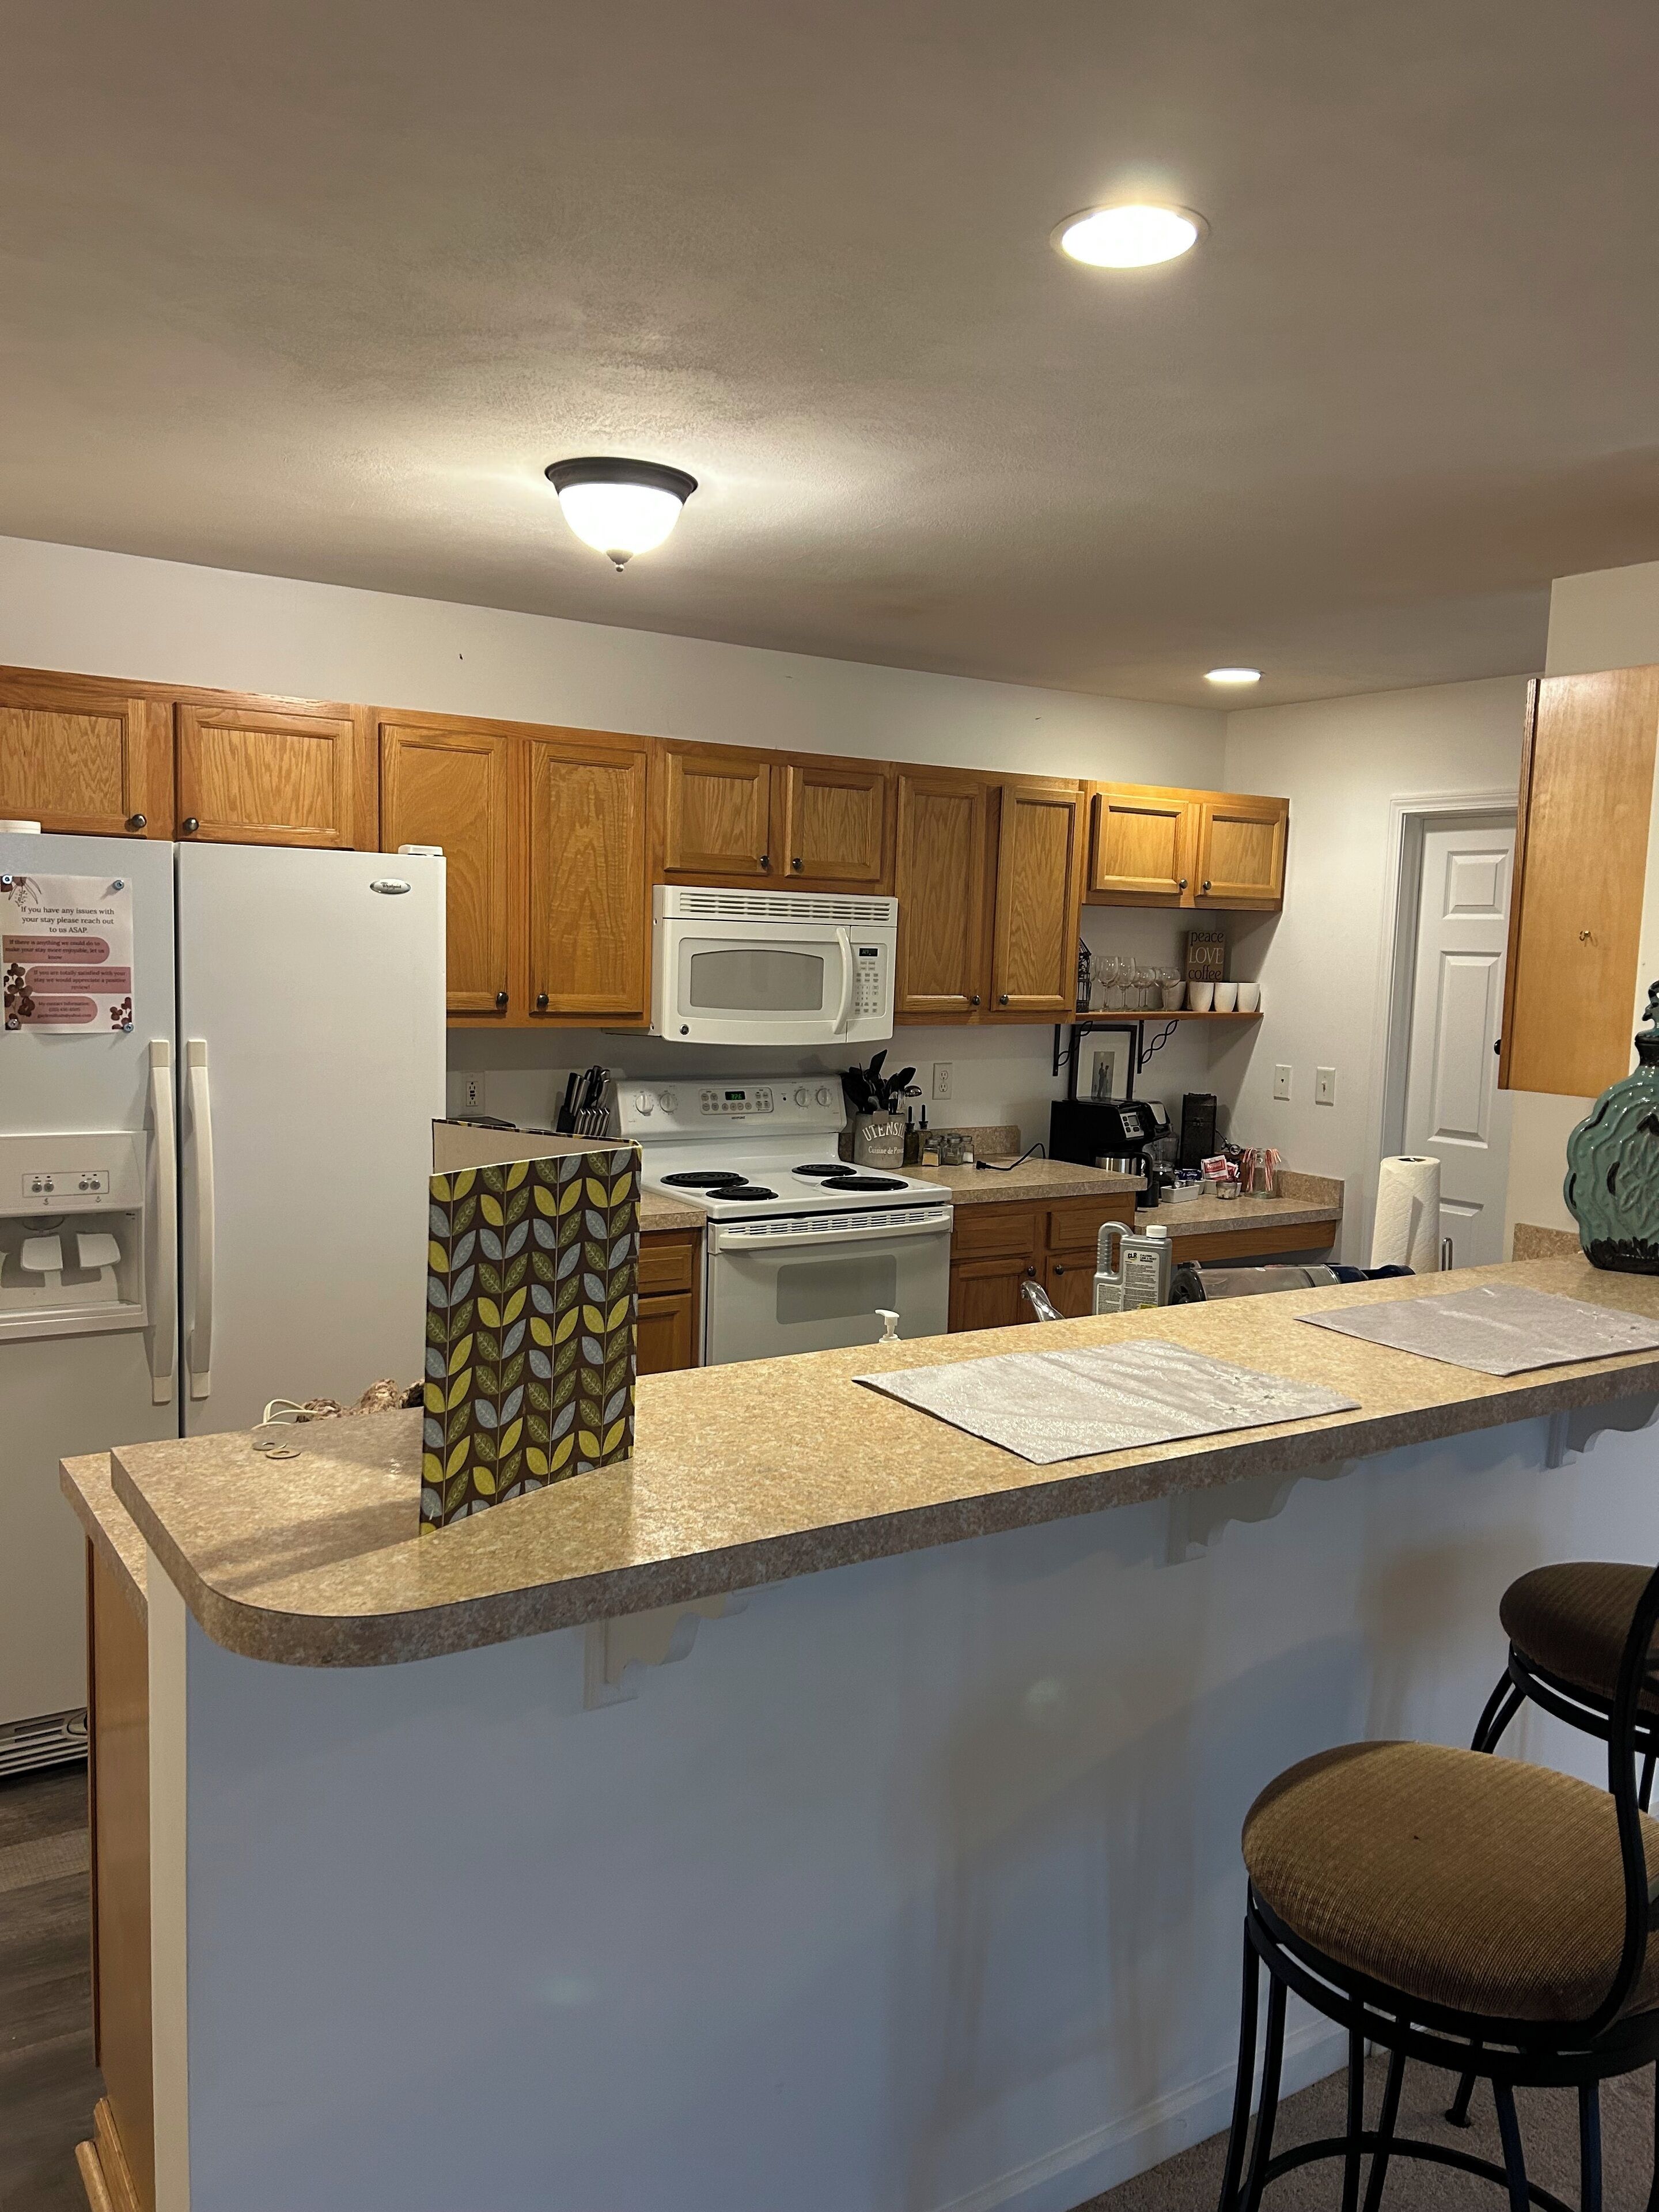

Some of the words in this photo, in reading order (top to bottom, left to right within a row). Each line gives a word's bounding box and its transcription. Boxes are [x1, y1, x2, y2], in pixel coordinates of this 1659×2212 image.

[1191, 931, 1224, 945] peace
[1188, 946, 1224, 964] LOVE
[1188, 964, 1221, 980] coffee
[868, 1146, 887, 1154] Cuisine
